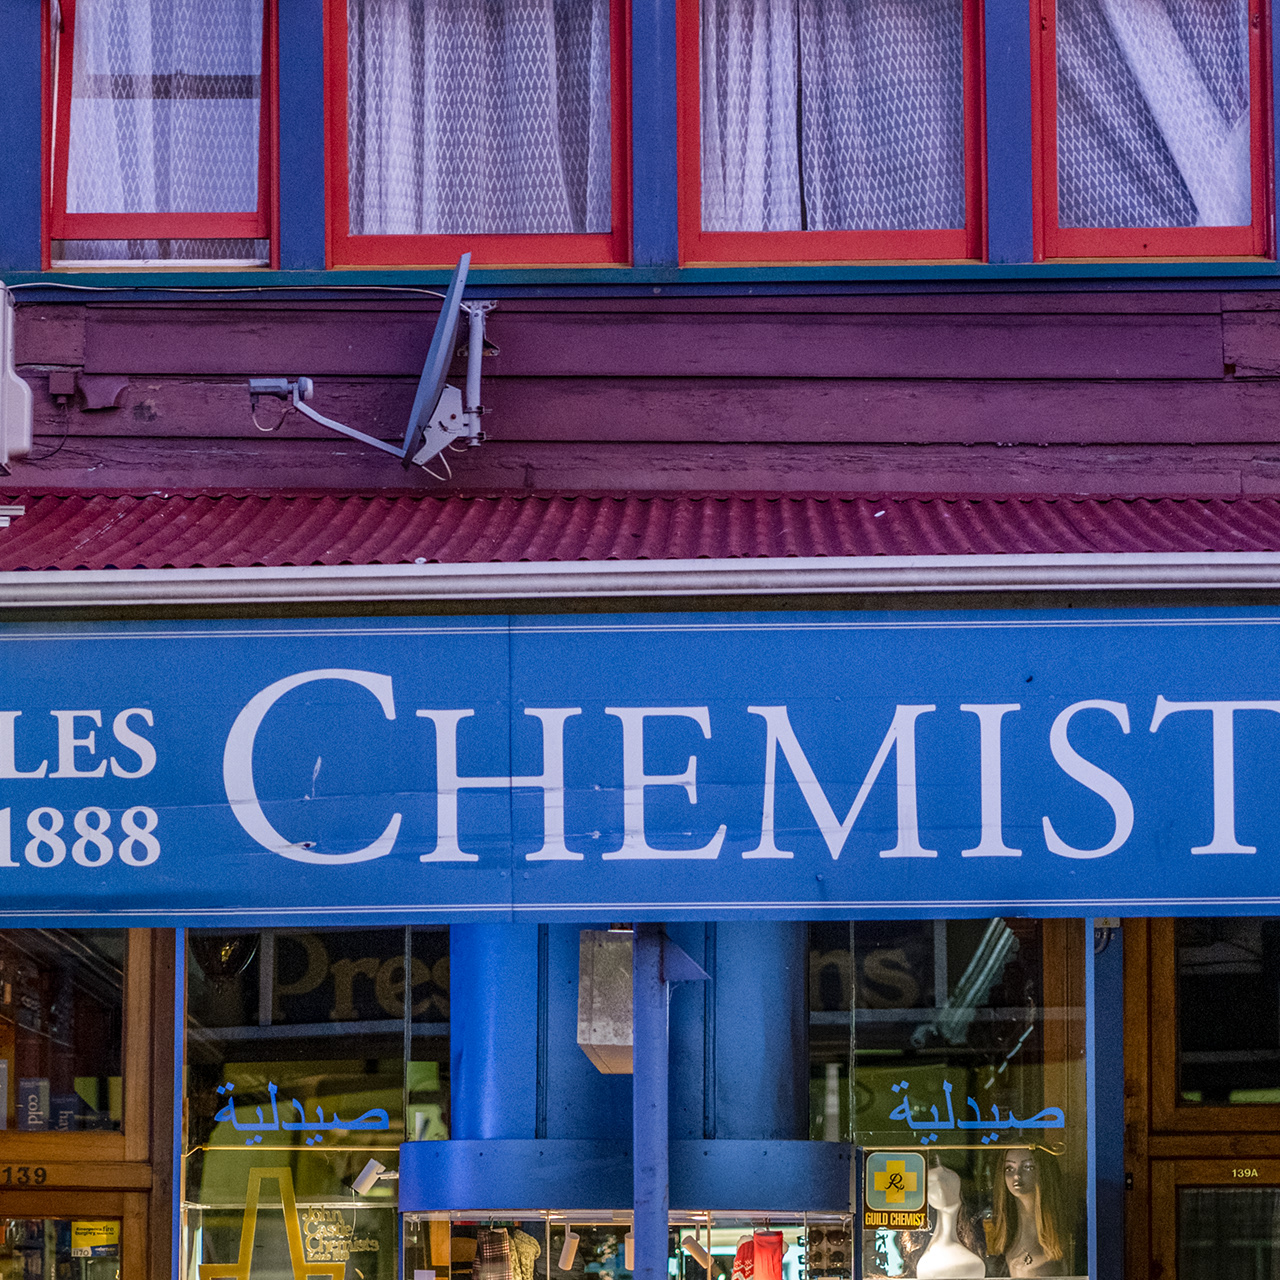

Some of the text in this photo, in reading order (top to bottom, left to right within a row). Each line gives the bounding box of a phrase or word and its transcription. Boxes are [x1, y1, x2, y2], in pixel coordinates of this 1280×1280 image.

[27, 1094, 44, 1125] cold
[214, 1081, 389, 1147] صيدلية
[889, 1079, 1065, 1145] صيدلية
[2, 1166, 47, 1185] 139
[1231, 1168, 1259, 1178] 139A
[302, 1205, 343, 1221] John
[865, 1212, 926, 1227] GUILD CHEMIST
